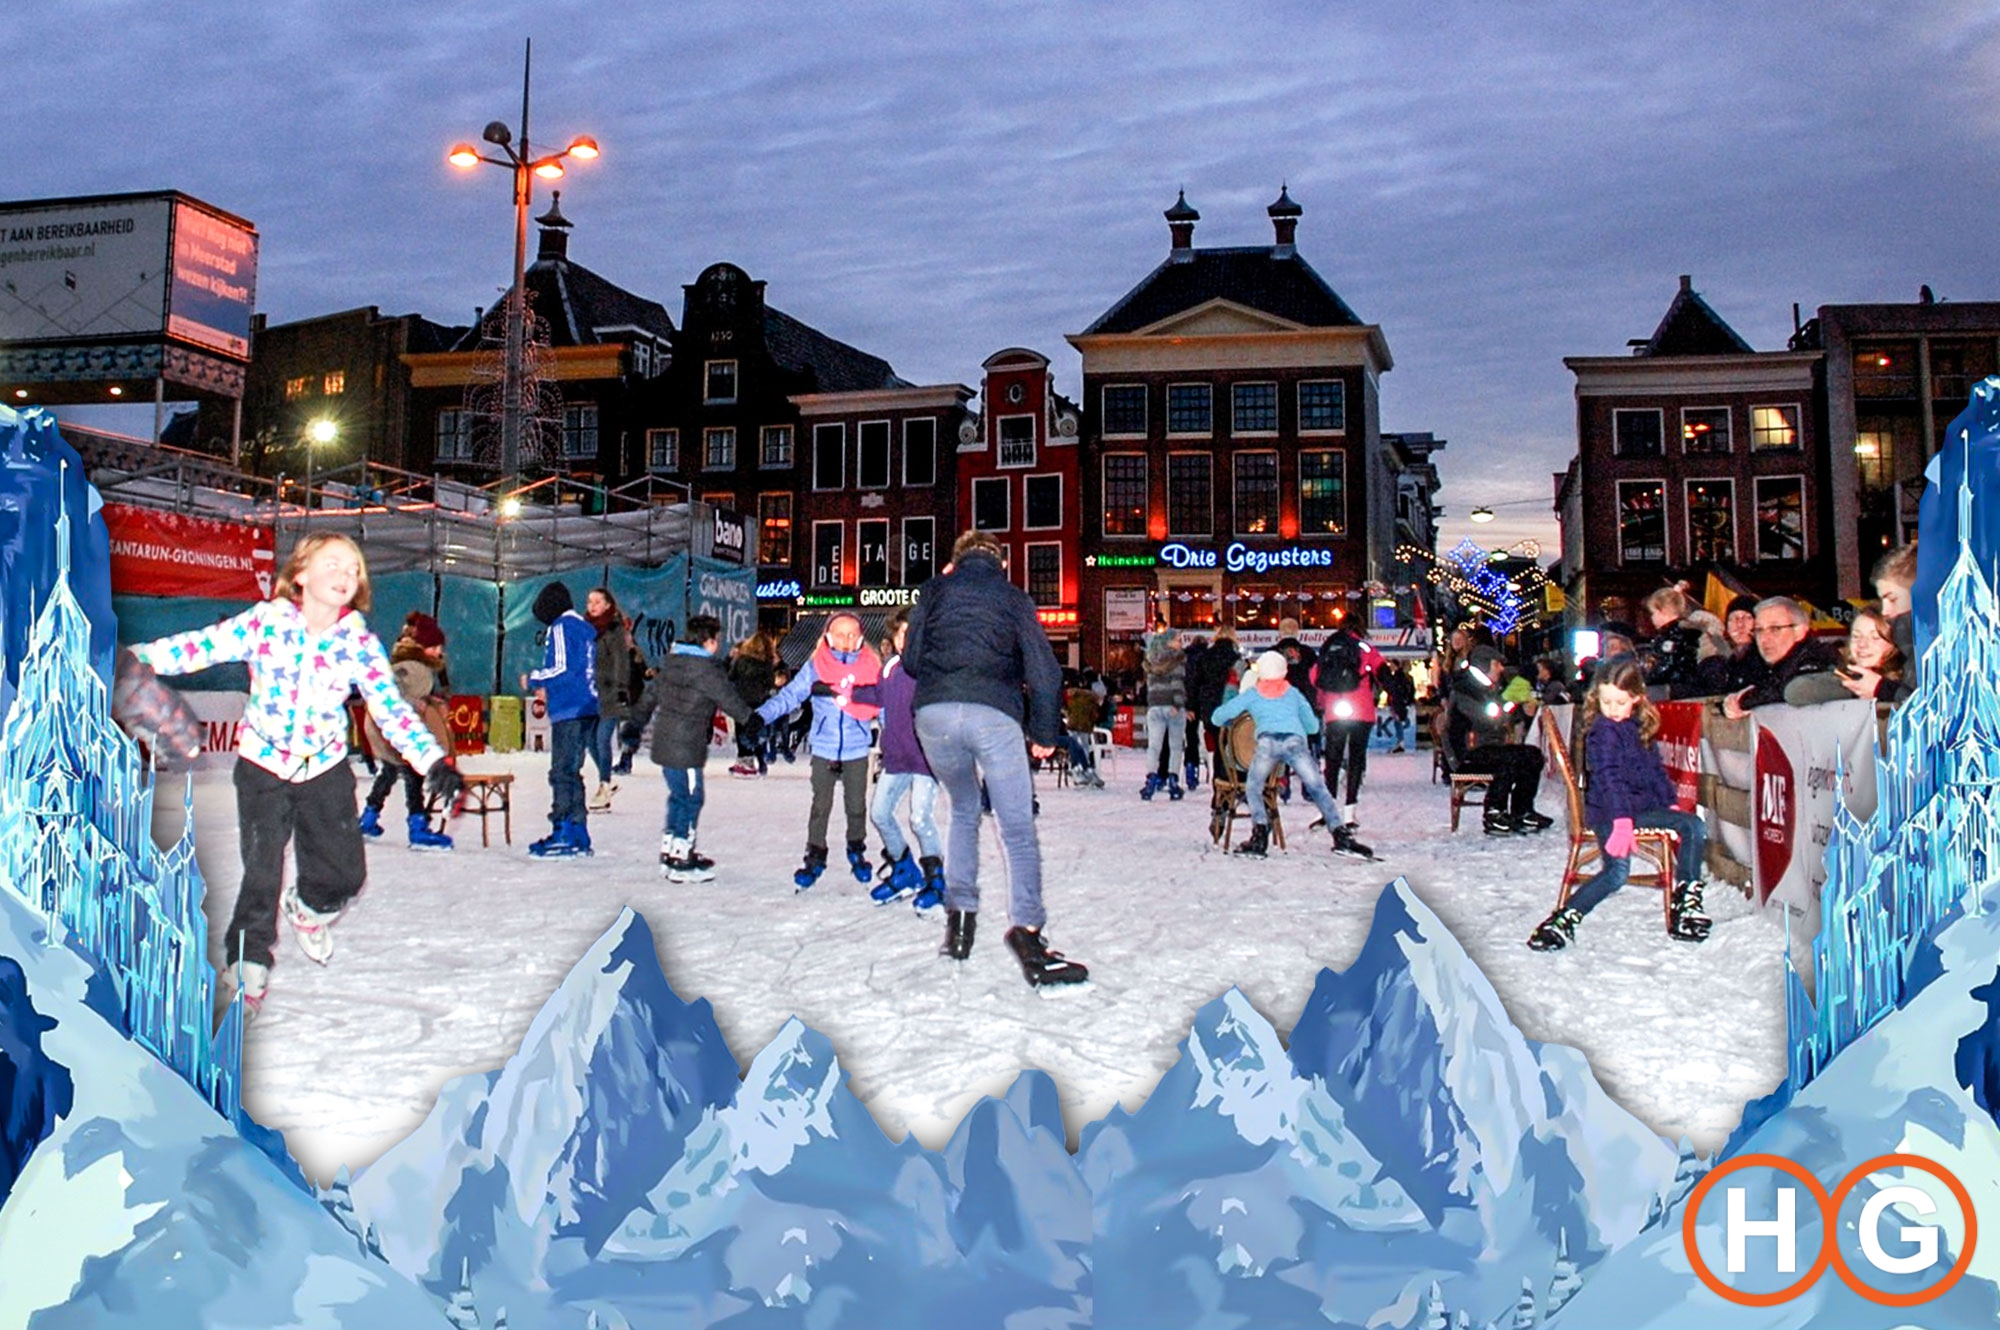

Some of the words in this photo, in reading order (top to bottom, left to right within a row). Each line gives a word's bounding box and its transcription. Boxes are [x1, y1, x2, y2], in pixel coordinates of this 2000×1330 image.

[9, 227, 33, 241] AAN
[37, 218, 134, 240] BEREIKBAARHEID
[715, 508, 743, 549] bano
[109, 539, 253, 571] SANTARUN-GRONINGEN.NL
[1098, 555, 1156, 566] Heineken
[1160, 543, 1217, 568] Drie
[1226, 543, 1332, 573] Gezusters
[806, 594, 853, 605] Heineken
[860, 589, 909, 606] GROOTE
